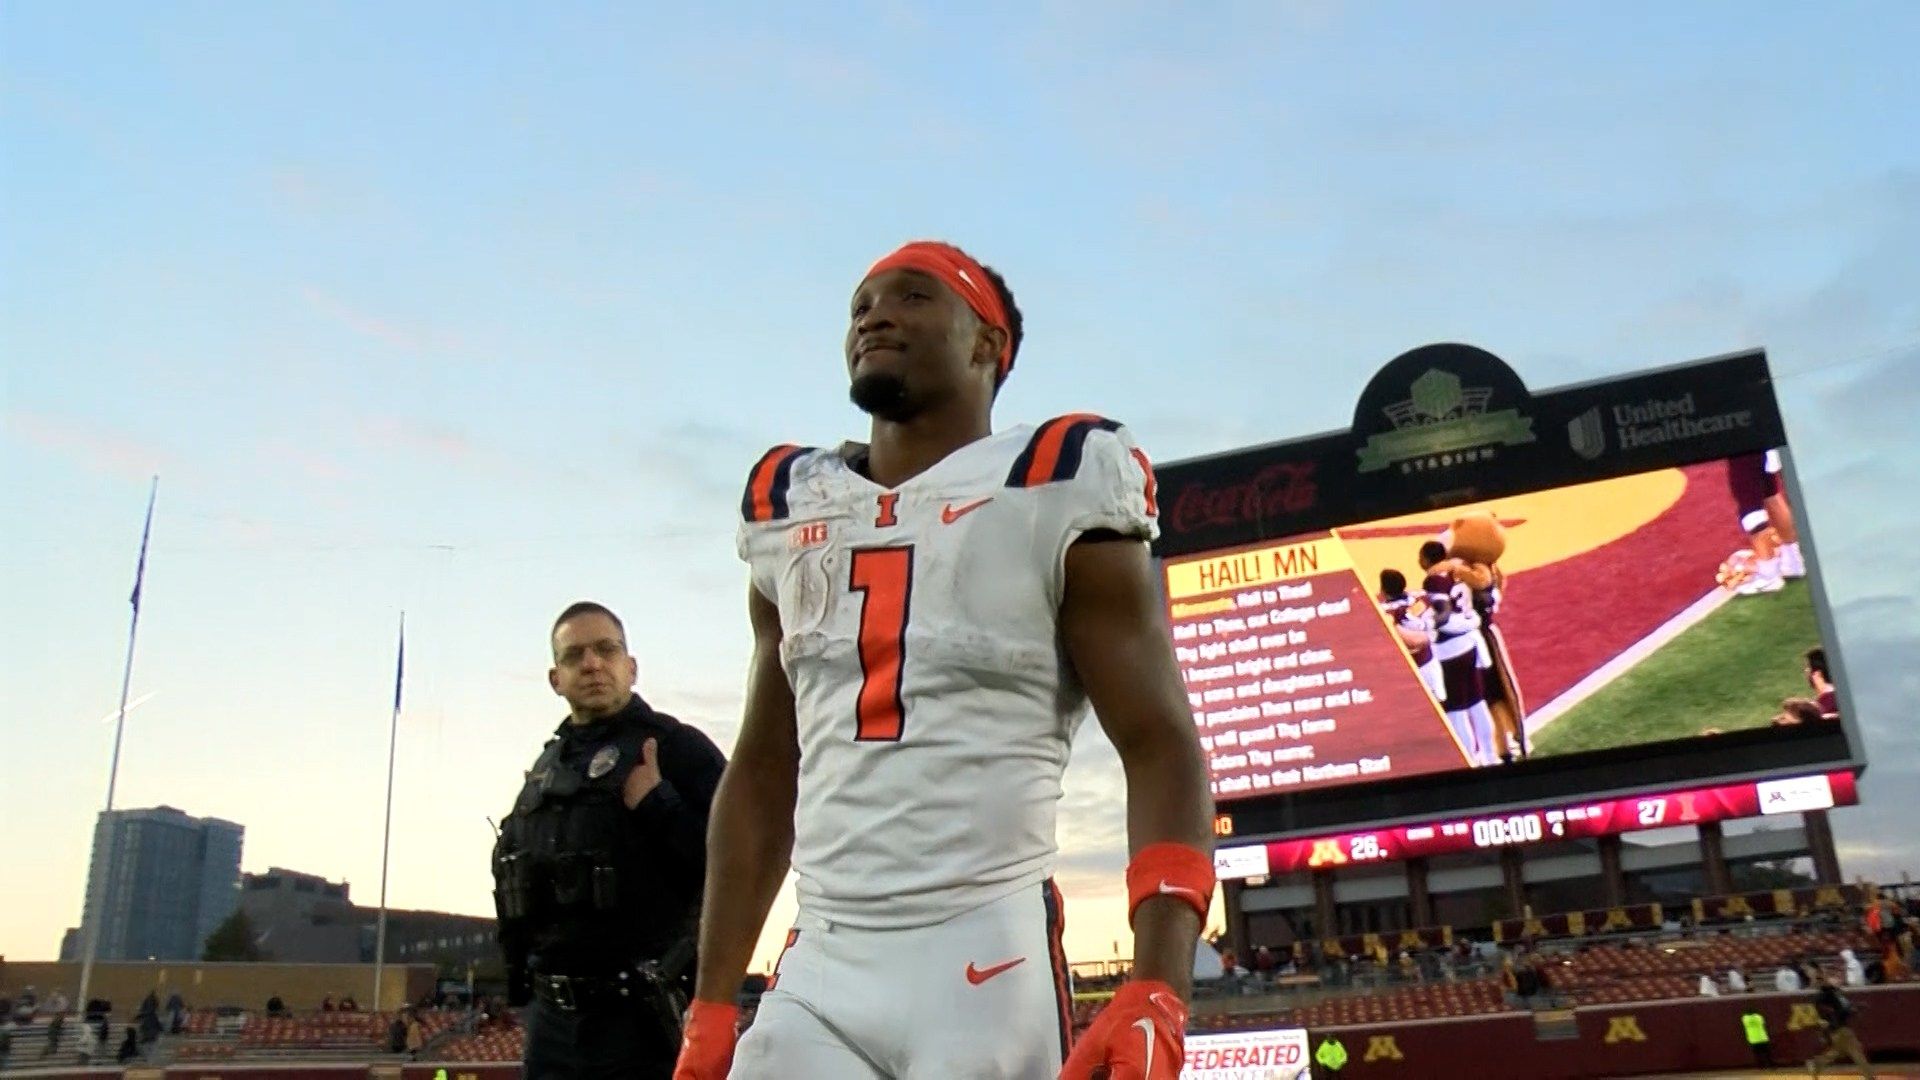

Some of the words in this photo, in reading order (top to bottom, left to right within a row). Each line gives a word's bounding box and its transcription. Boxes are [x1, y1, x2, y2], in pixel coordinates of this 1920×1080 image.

[1612, 392, 1696, 425] United
[1617, 409, 1752, 449] Healthcare
[1400, 447, 1496, 475] STADIUM
[875, 492, 899, 528] I
[1200, 554, 1261, 590] HAIL!
[1273, 545, 1319, 577] MN
[849, 544, 915, 742] 1
[1637, 797, 1667, 825] 27
[1472, 814, 1543, 847] 00:00
[1308, 839, 1348, 867] M
[1604, 1015, 1647, 1043] M
[1184, 1043, 1301, 1070] FEDERATED
[1363, 1035, 1403, 1062] M
